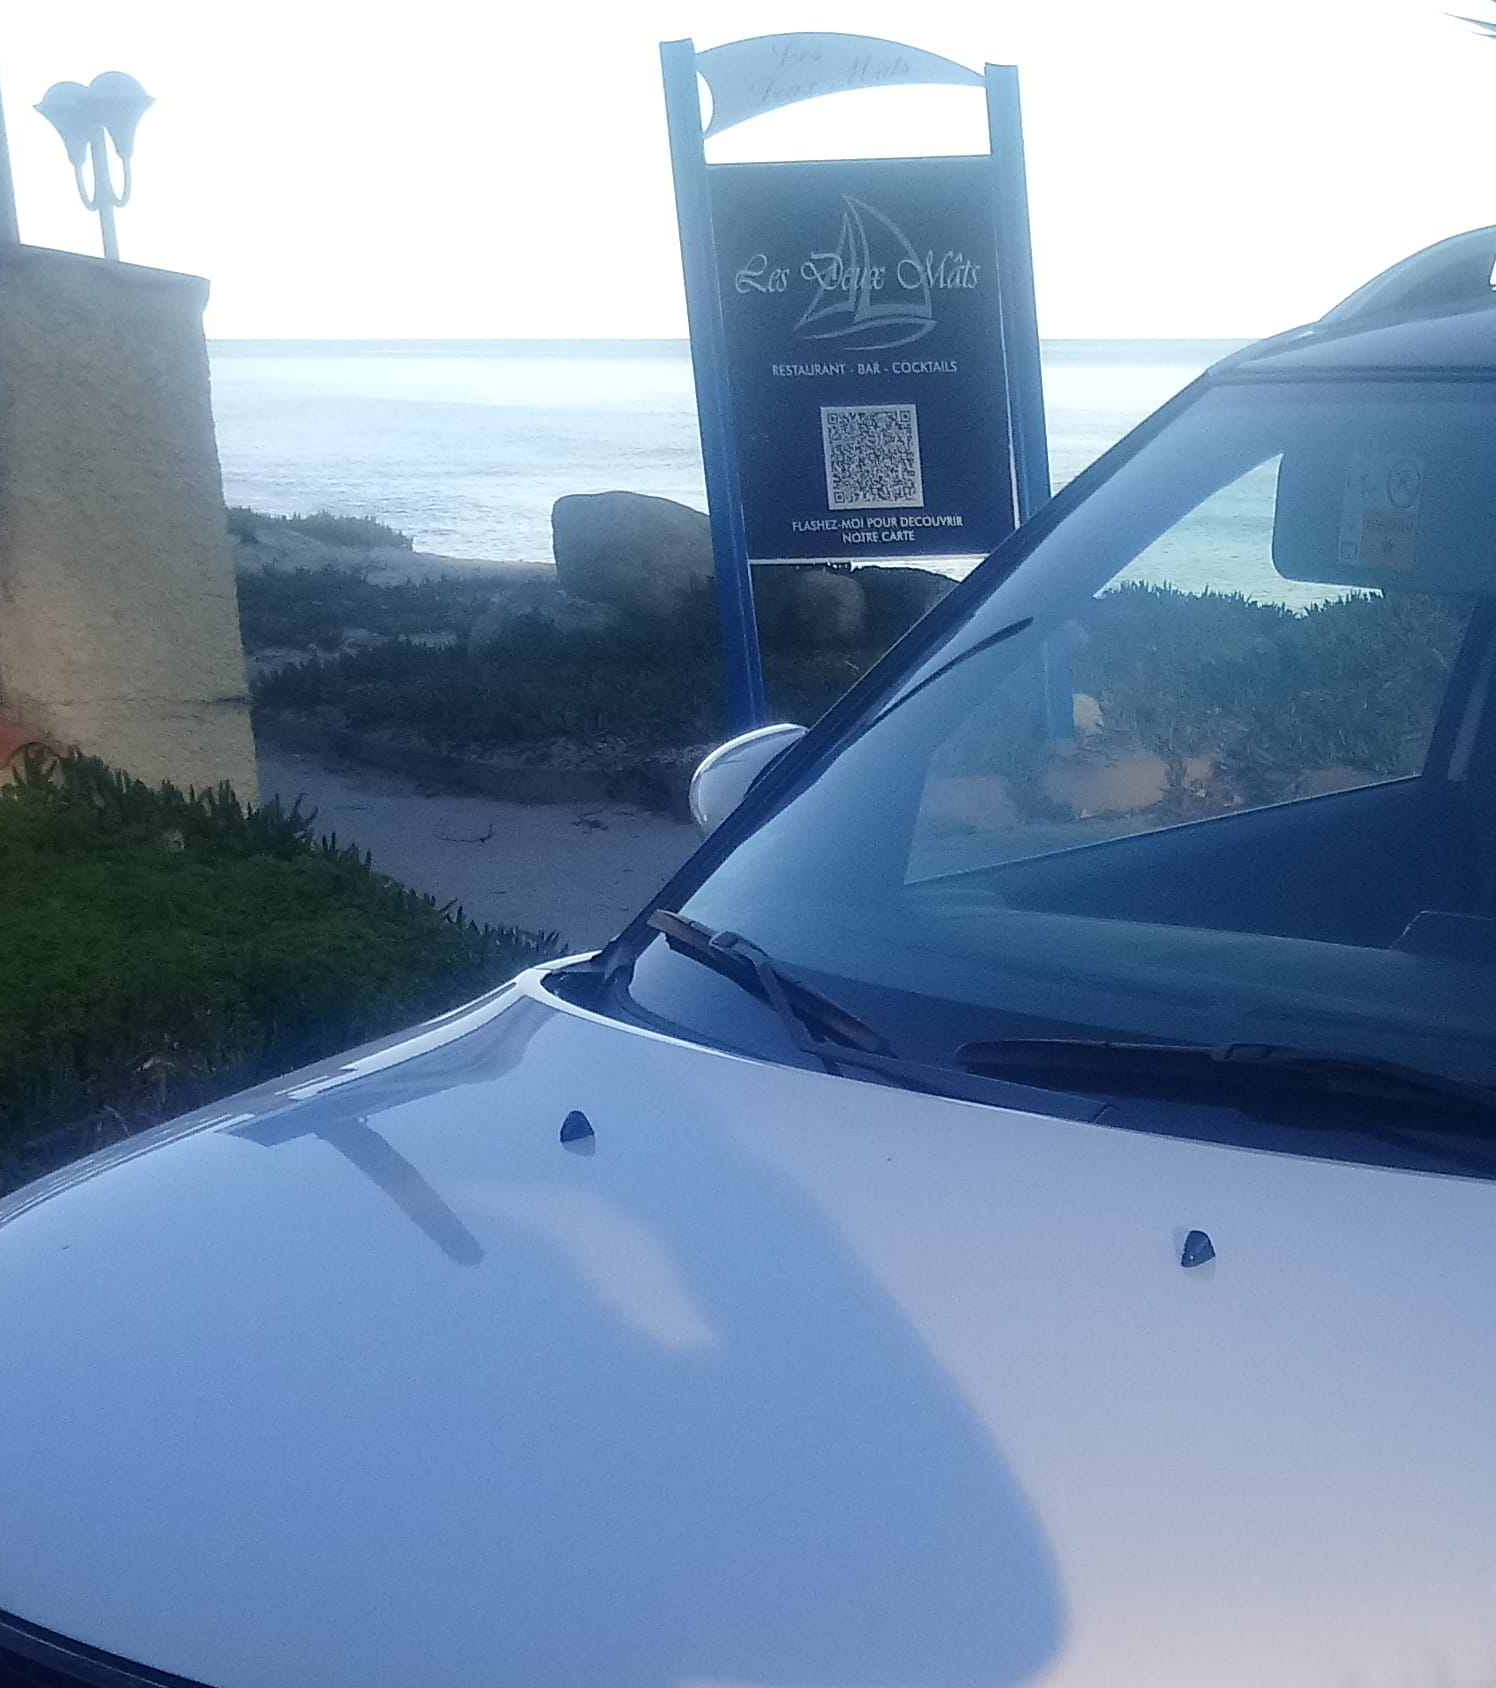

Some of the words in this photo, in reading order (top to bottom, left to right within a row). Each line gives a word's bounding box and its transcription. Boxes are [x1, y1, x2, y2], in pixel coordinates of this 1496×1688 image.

[735, 254, 790, 294] Les
[800, 251, 886, 290] Deux
[897, 249, 981, 290] Mâts
[771, 362, 846, 377] RESTAURANT
[857, 361, 881, 375] BAR
[892, 360, 958, 375] COCKTAILS
[791, 517, 864, 532] FLASHEZ-MOI
[867, 516, 897, 529] POUR
[841, 531, 878, 544] NOTRE
[881, 529, 916, 543] CARTE
